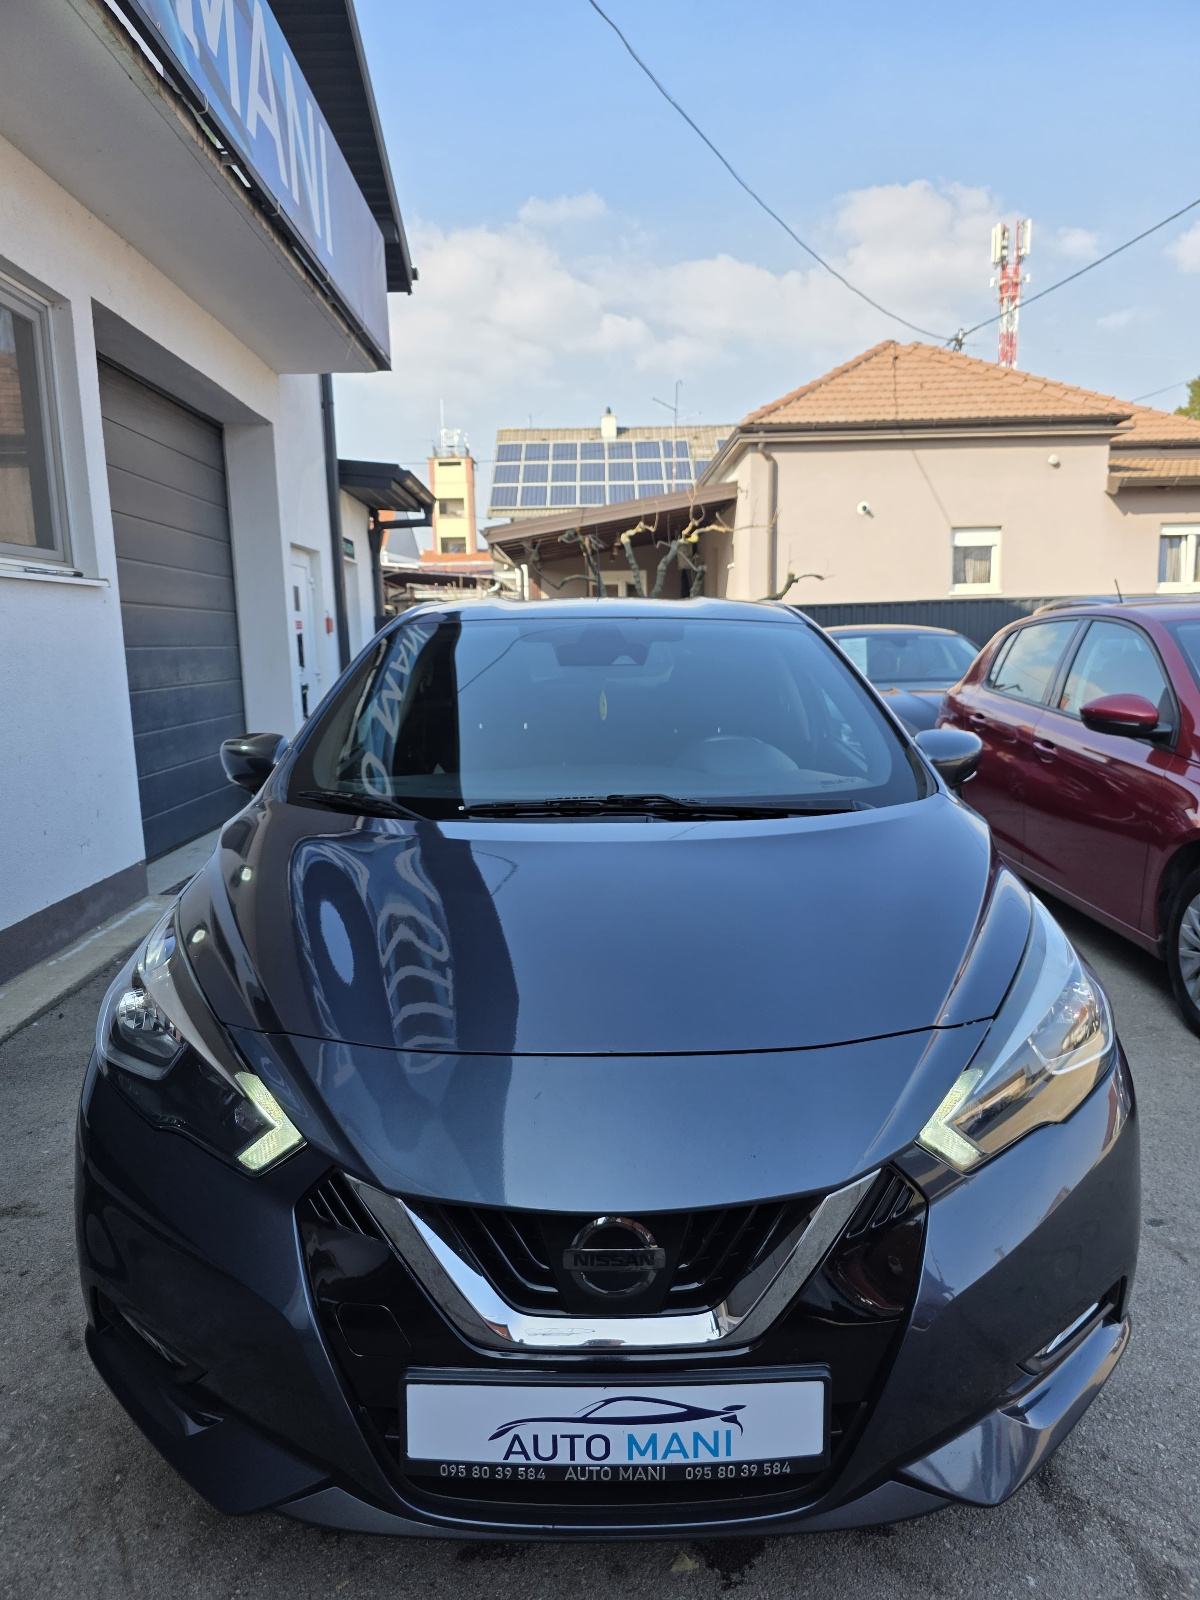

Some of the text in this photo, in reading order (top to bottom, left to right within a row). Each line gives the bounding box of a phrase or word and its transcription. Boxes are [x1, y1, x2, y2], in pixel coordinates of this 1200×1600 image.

[573, 1253, 656, 1267] NISSAN
[502, 1429, 732, 1462] AUTO MANI
[439, 1461, 791, 1481] 095 80 39 584 AUTO MANI 095 80 39 584
